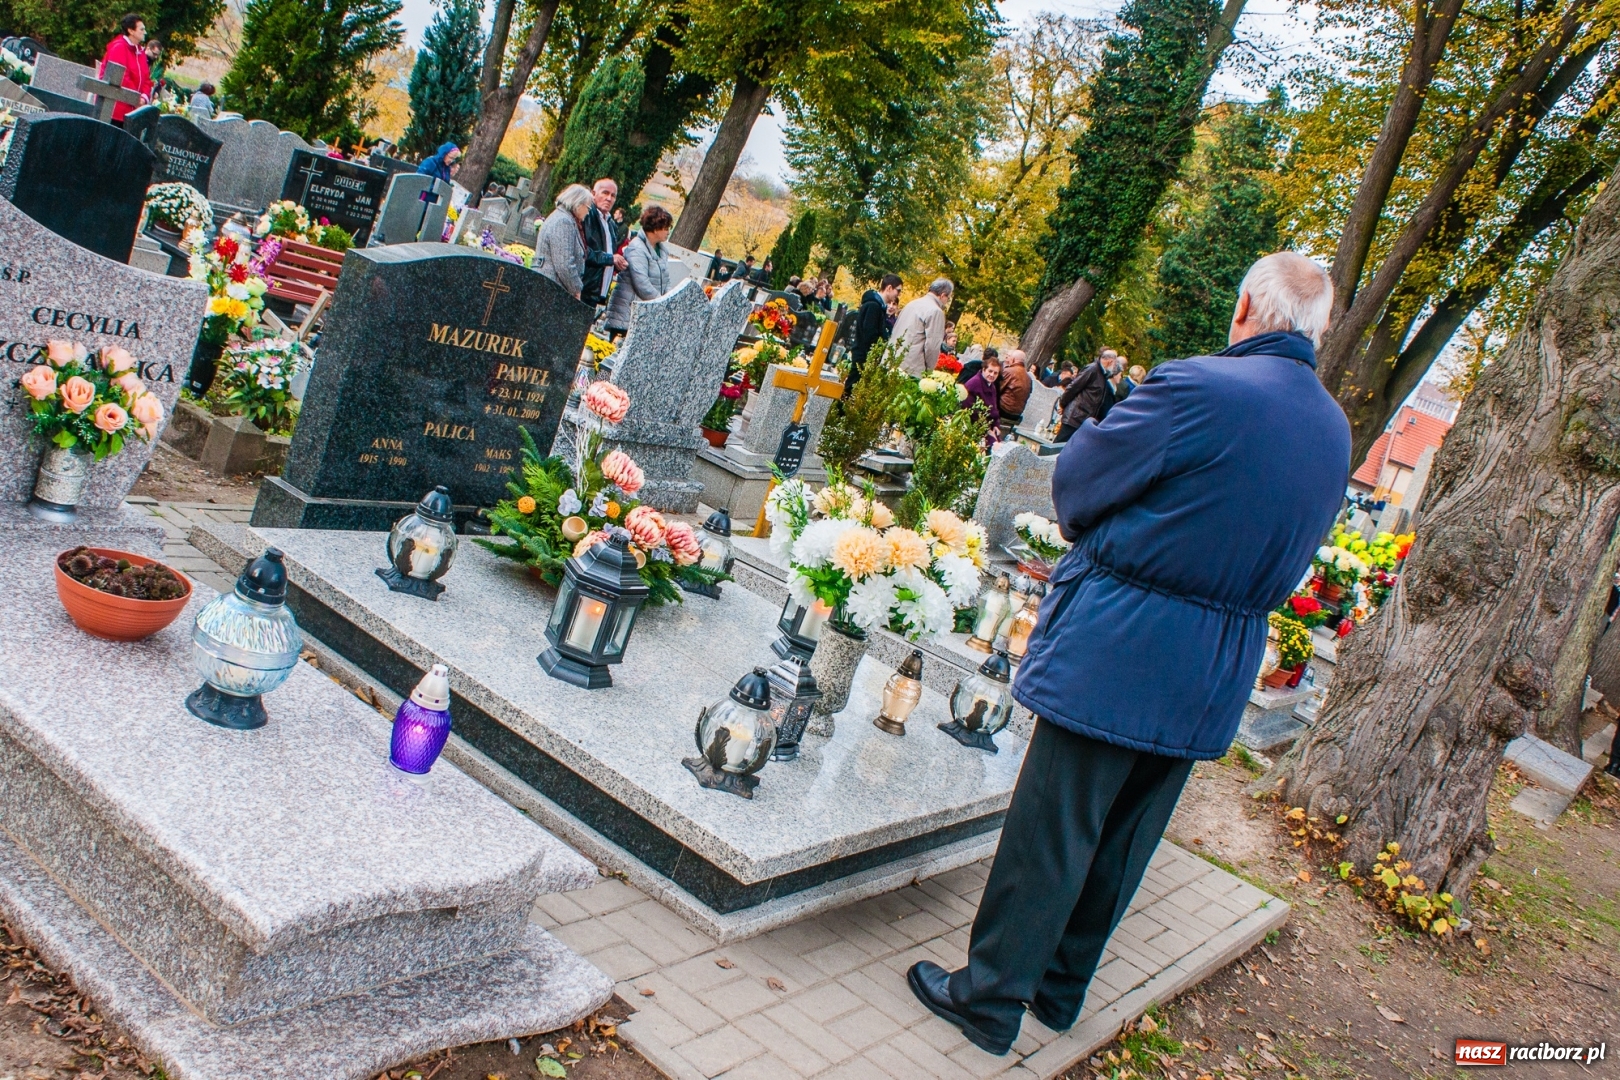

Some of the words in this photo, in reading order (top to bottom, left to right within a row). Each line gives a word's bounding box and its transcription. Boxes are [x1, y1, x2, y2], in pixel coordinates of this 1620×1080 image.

[161, 143, 210, 164] KLIMOWICZ
[168, 155, 199, 169] STEFAN
[333, 174, 367, 192] DUDEK
[310, 183, 345, 200] ELFRYDA
[355, 194, 372, 206] JAN
[32, 306, 141, 340] CECYLIA
[427, 323, 528, 358] MAZUREK
[496, 363, 551, 387] PAWEŁ
[526, 391, 546, 404] 1924
[520, 408, 541, 420] 2009
[423, 421, 476, 441] PALICA
[371, 437, 404, 451] ANNA
[358, 453, 379, 465] 1915
[484, 447, 513, 461] MAKS
